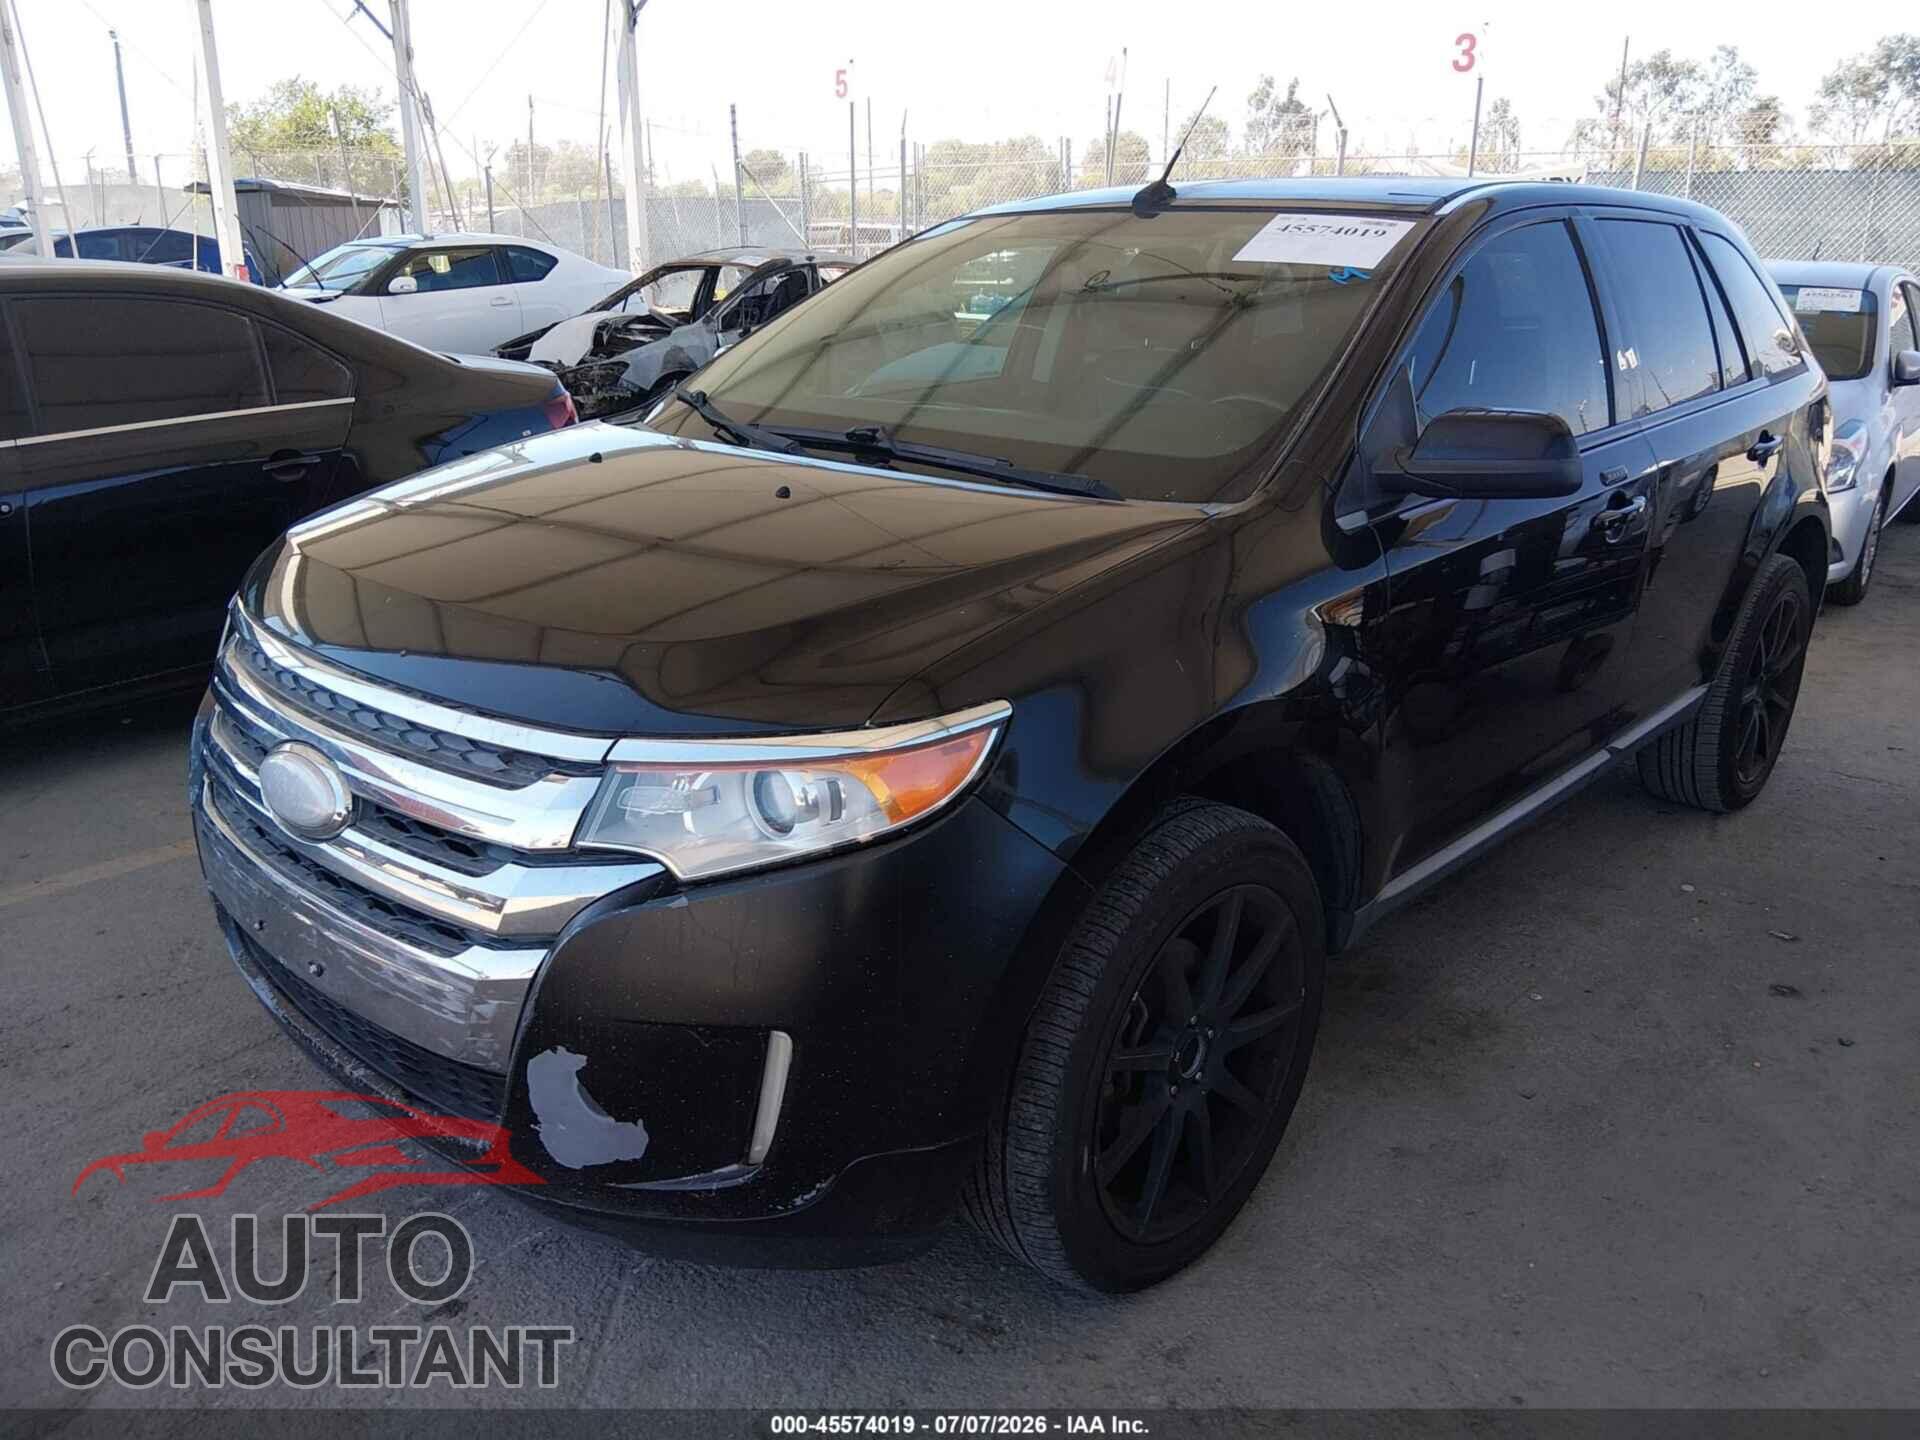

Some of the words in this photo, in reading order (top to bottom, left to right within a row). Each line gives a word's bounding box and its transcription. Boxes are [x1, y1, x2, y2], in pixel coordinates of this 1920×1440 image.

[1452, 33, 1476, 72] 3
[835, 69, 848, 98] 5
[1276, 223, 1387, 238] 45574019
